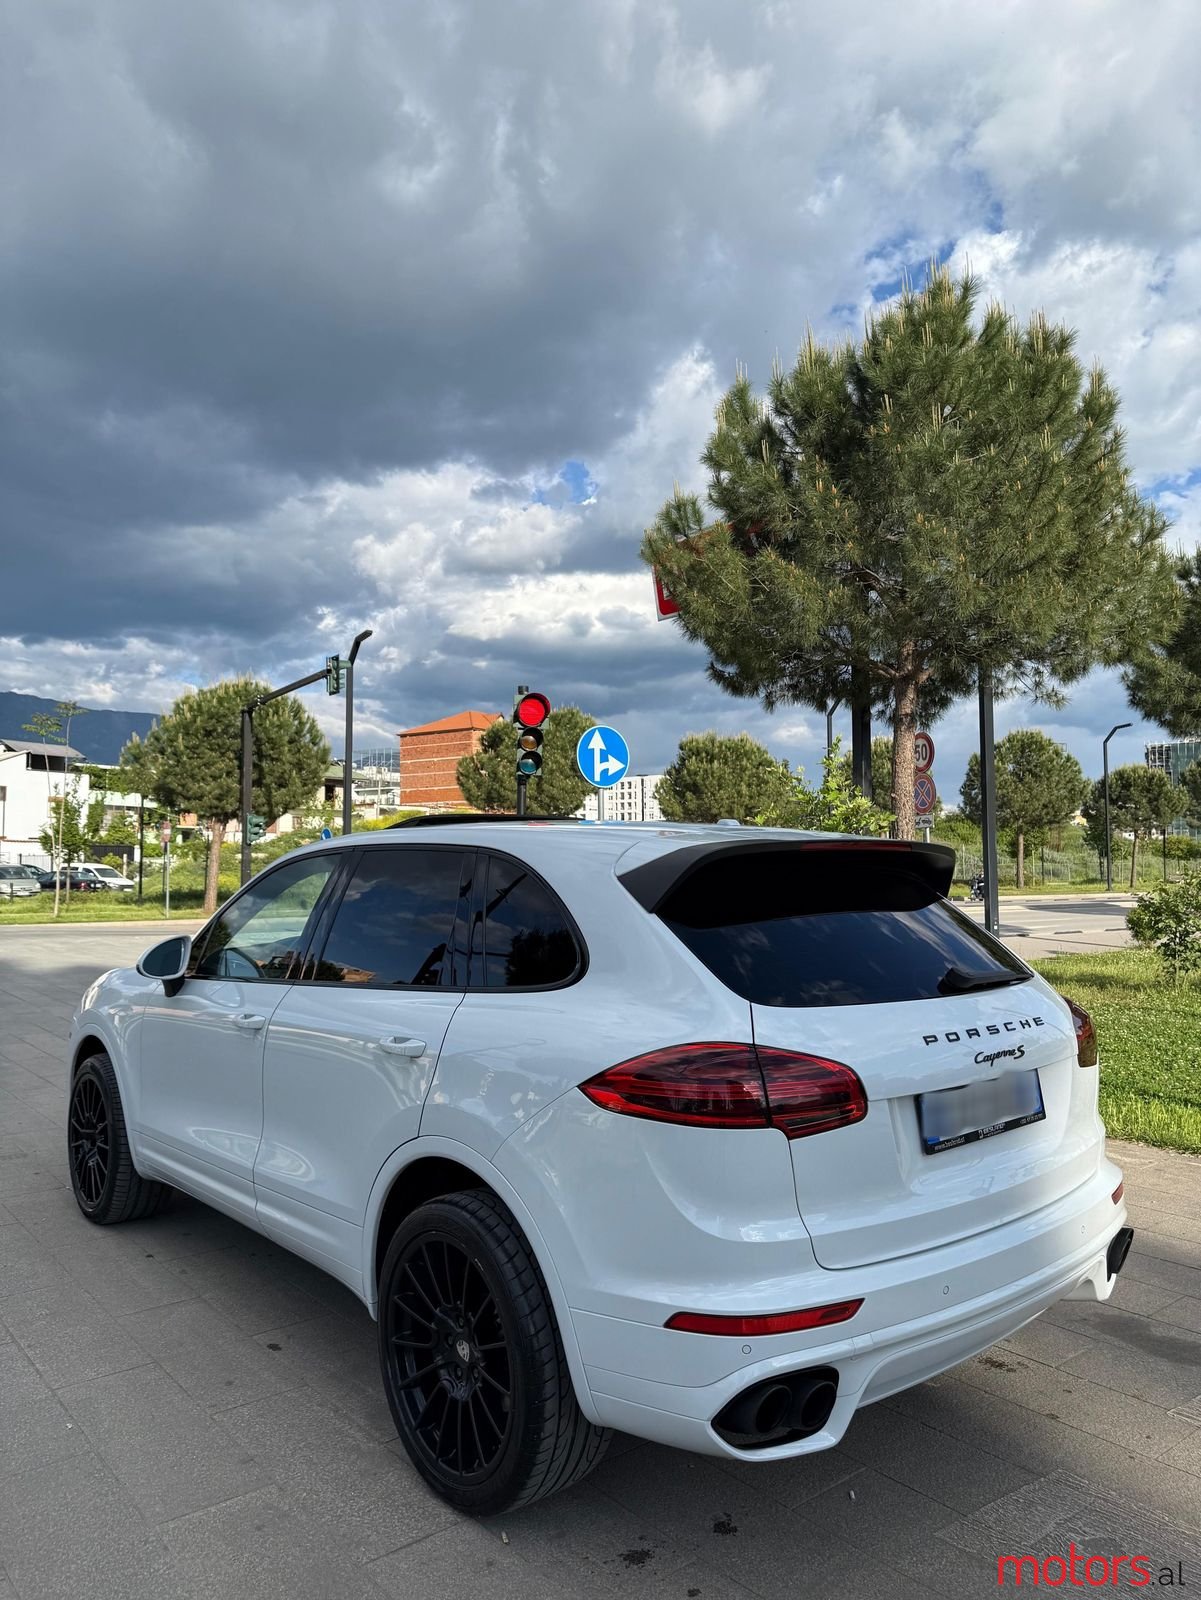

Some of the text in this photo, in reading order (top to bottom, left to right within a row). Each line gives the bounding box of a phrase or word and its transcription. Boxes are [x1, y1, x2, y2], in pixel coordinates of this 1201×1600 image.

[915, 743, 928, 762] 50
[923, 1016, 1045, 1046] PORSCHE
[974, 1045, 1025, 1067] Cayenne S
